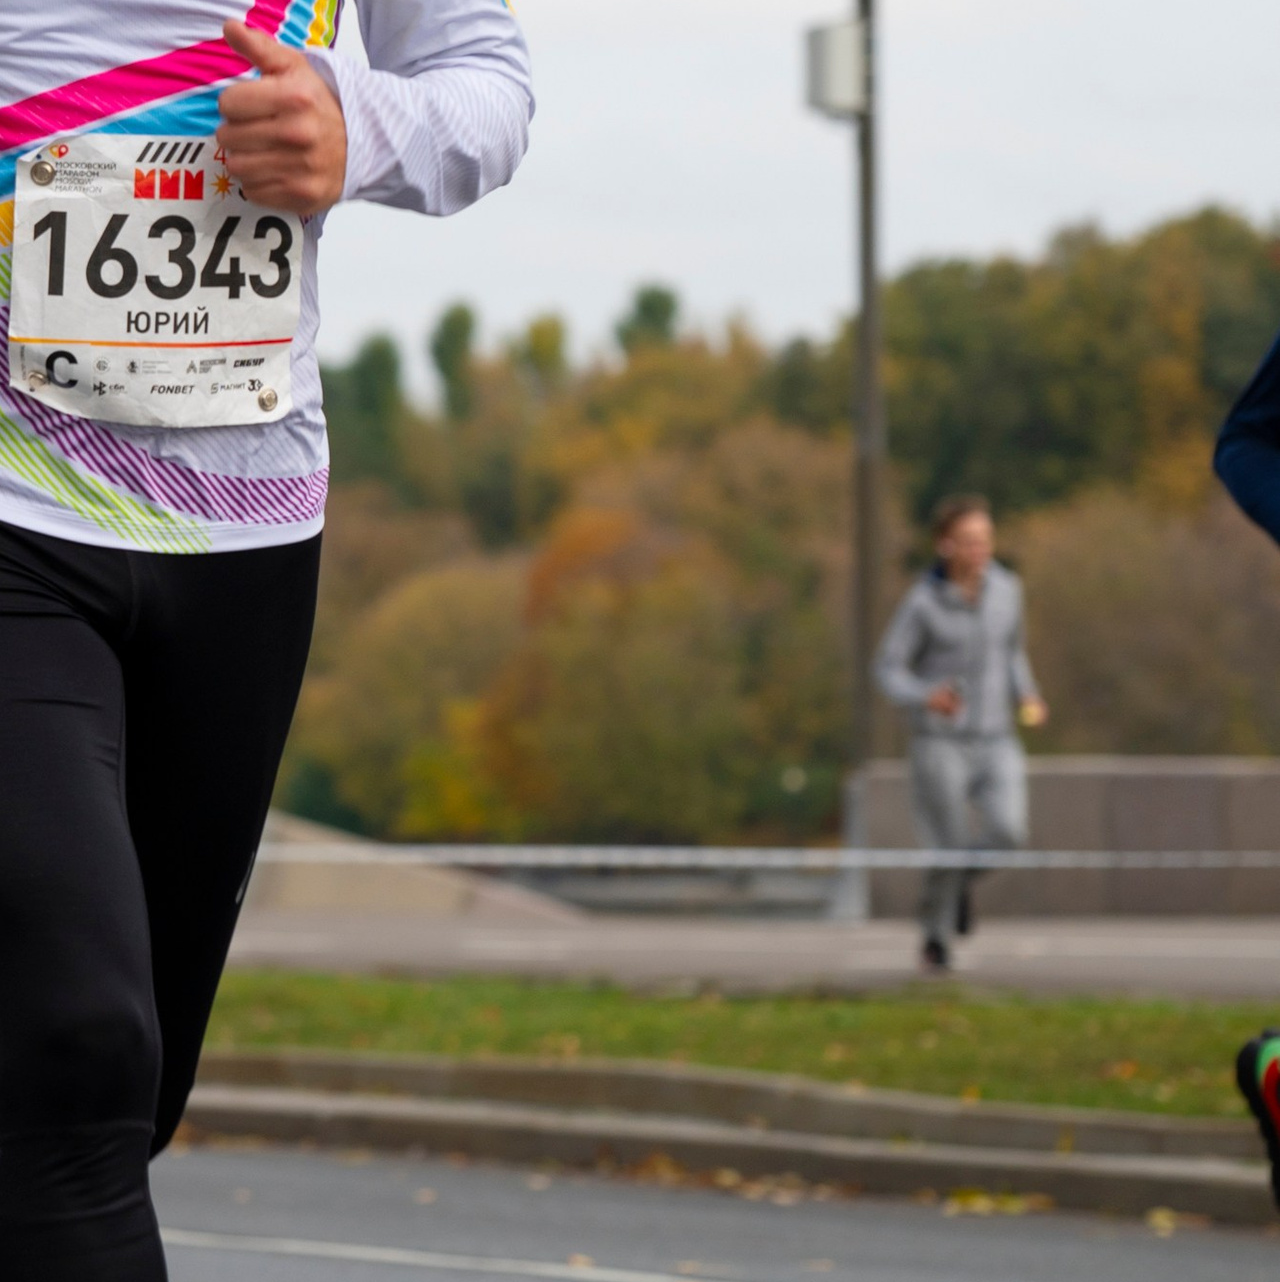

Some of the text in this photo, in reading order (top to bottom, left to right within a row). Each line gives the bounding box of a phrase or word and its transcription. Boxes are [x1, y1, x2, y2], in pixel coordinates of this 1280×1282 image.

[55, 161, 117, 171] МОСКОВСКИЙ
[55, 170, 100, 178] МАРАФОН
[54, 185, 103, 193] MARATHON
[32, 210, 293, 300] 16343
[126, 306, 210, 335] ЮРИЙ
[150, 384, 195, 395] FONBET
